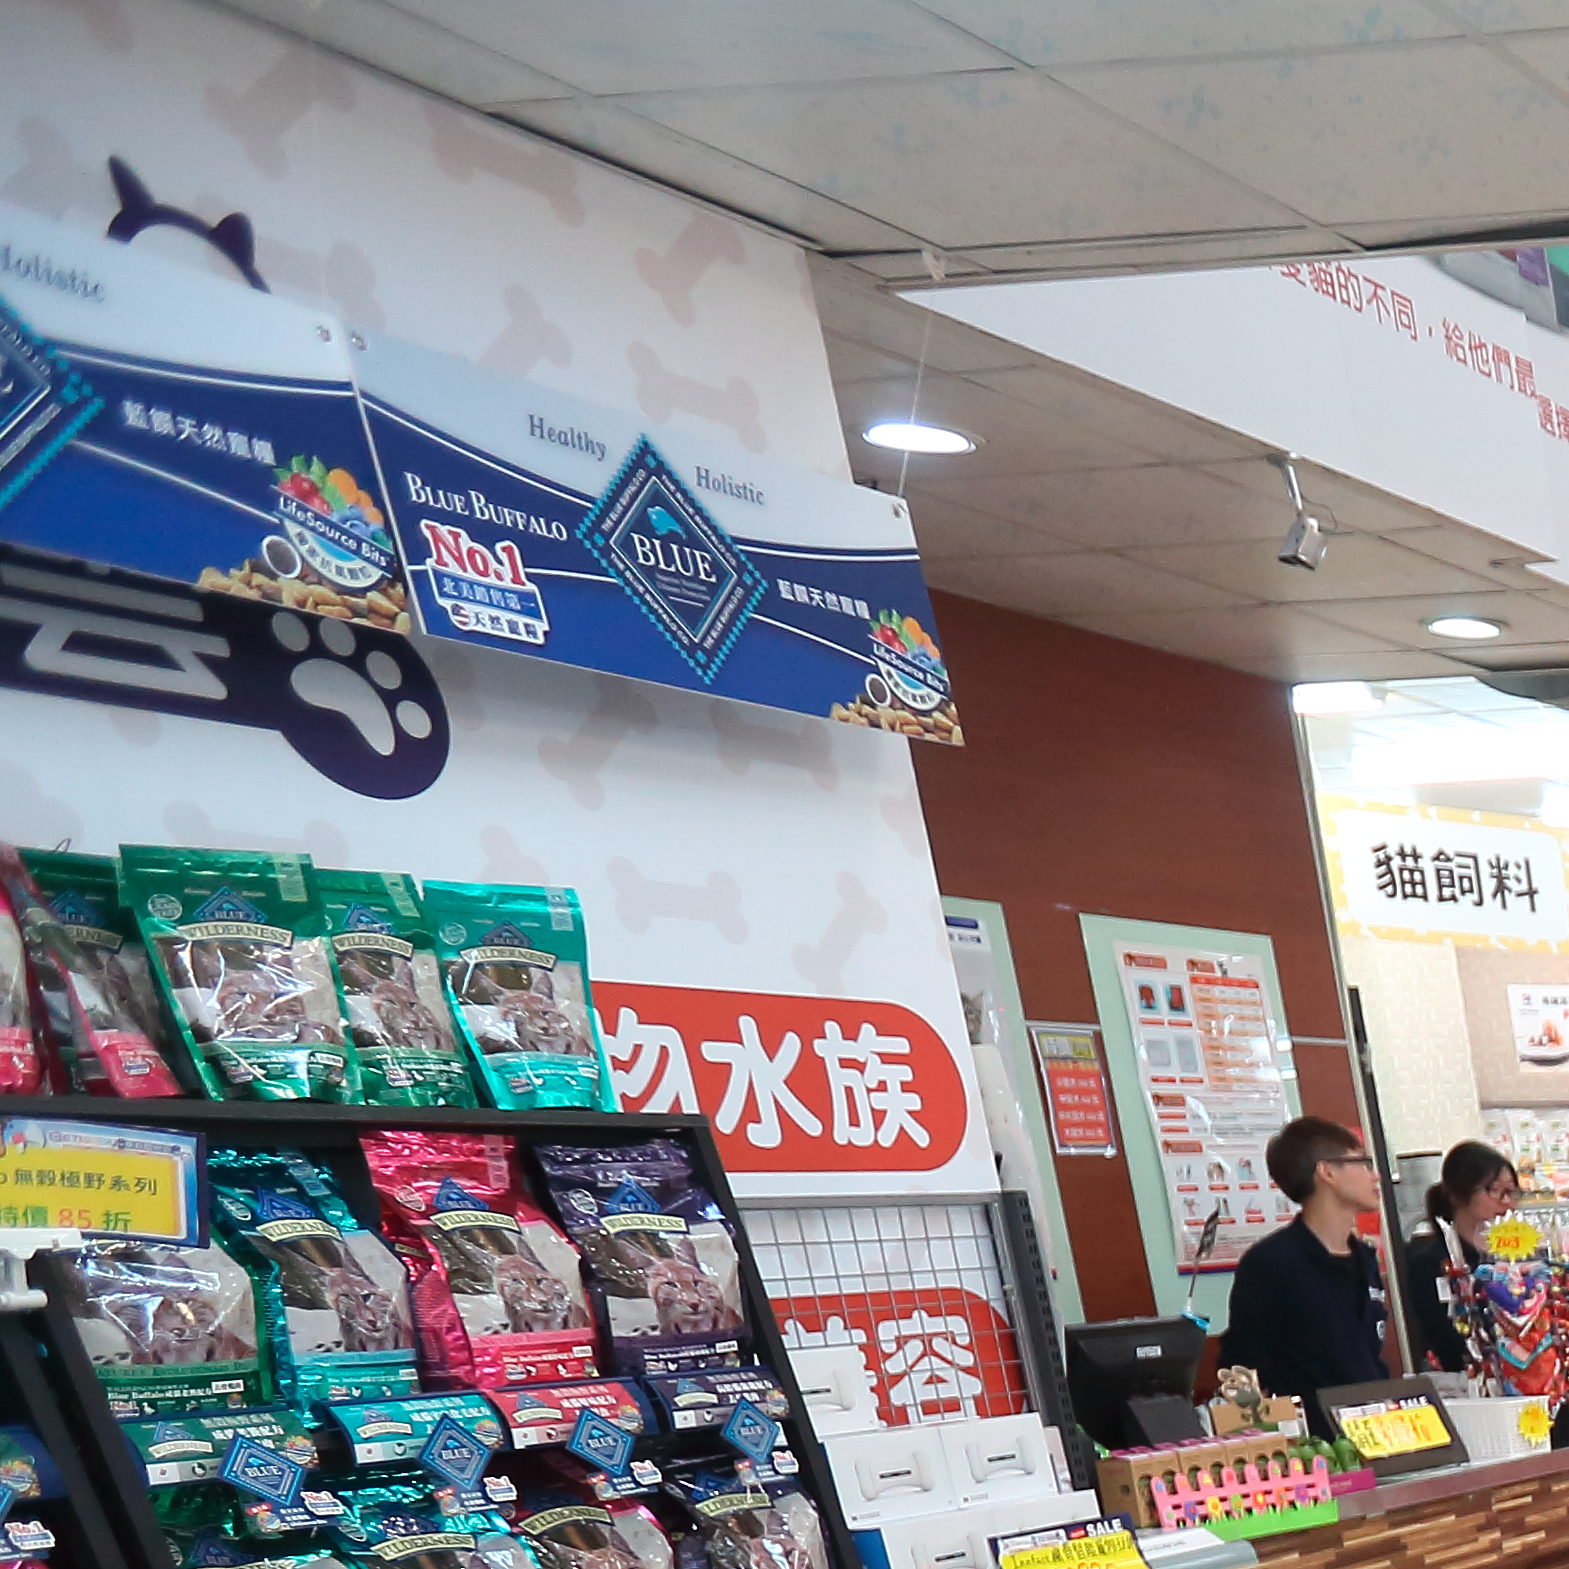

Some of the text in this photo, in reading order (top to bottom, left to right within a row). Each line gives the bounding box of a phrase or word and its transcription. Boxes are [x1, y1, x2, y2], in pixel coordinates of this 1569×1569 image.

[527, 413, 608, 462] Healthy
[694, 464, 766, 507] Holistic
[278, 494, 358, 553] LifeSource
[359, 539, 391, 569] Bits
[469, 489, 568, 542] BUFFALO
[422, 522, 526, 588] No.1
[631, 532, 719, 585] BLUE
[1372, 842, 1541, 914] 貓飼料
[334, 933, 413, 958] WILDERNESS
[598, 1006, 931, 1149] 物水族
[58, 1208, 92, 1230] 85
[104, 1208, 133, 1234] 折
[245, 1463, 280, 1477] BLUE
[441, 1447, 471, 1461] BLUE
[371, 1535, 476, 1560] WILDERNESS
[1085, 1518, 1124, 1537] SALE
